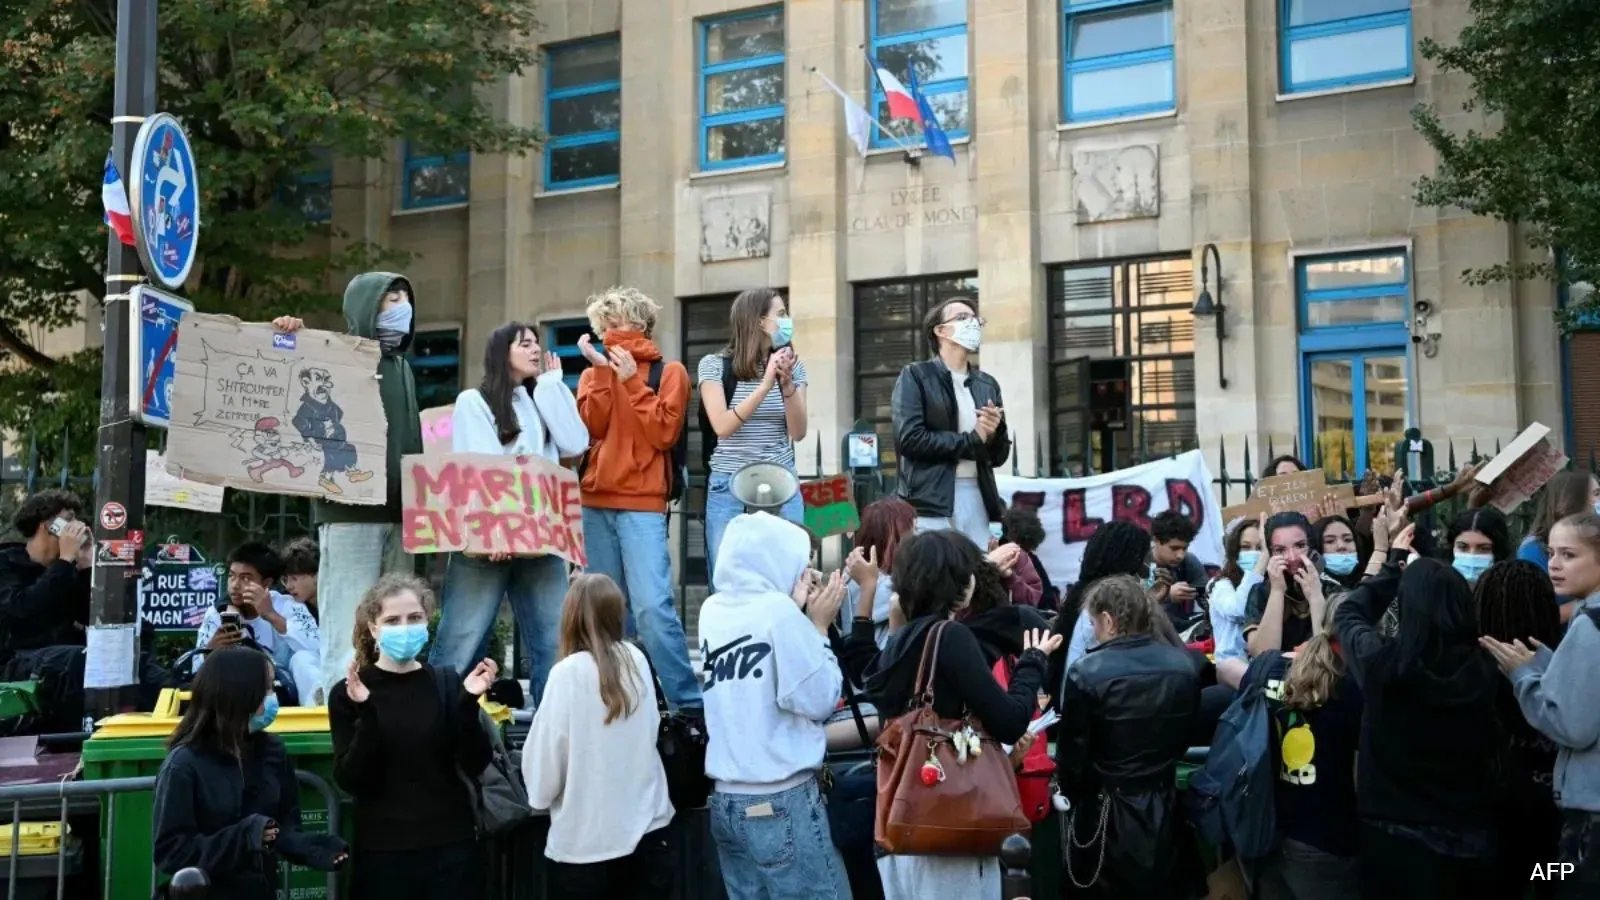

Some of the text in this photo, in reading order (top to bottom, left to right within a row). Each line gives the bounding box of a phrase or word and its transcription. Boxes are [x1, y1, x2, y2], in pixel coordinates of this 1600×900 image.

[264, 366, 278, 377] VA
[222, 394, 234, 406] TA
[1257, 485, 1277, 499] ET
[403, 508, 588, 568] EN PRISON
[158, 574, 187, 590] RUE
[150, 592, 217, 607] DOCTEUR
